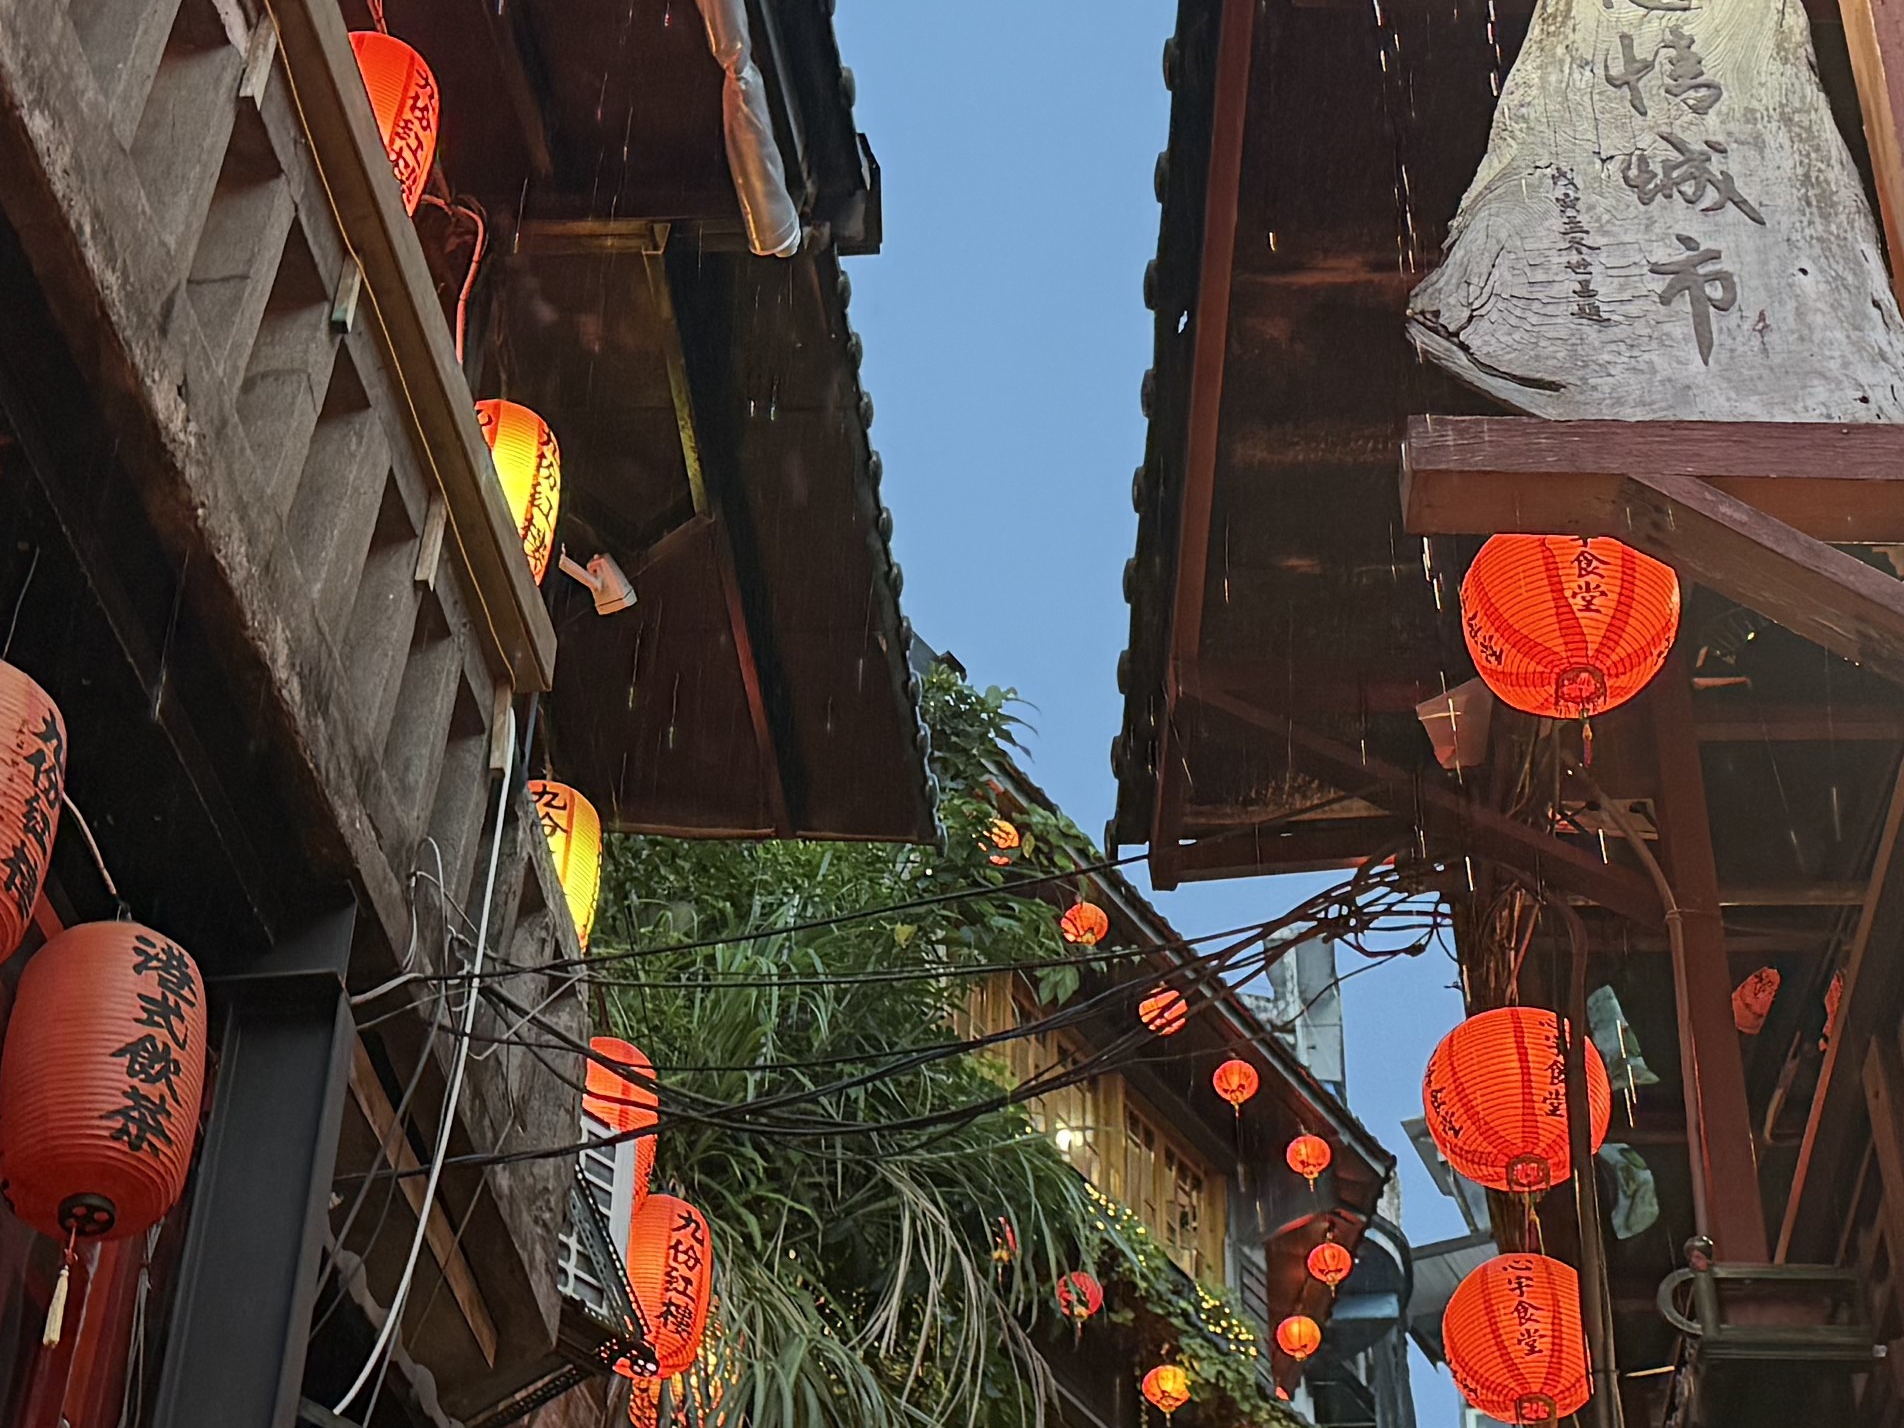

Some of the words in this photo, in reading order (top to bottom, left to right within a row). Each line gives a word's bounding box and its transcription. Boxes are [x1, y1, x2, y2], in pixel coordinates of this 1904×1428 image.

[103, 932, 196, 1156] 港式飲茶
[655, 1209, 705, 1344] 九份紅樓
